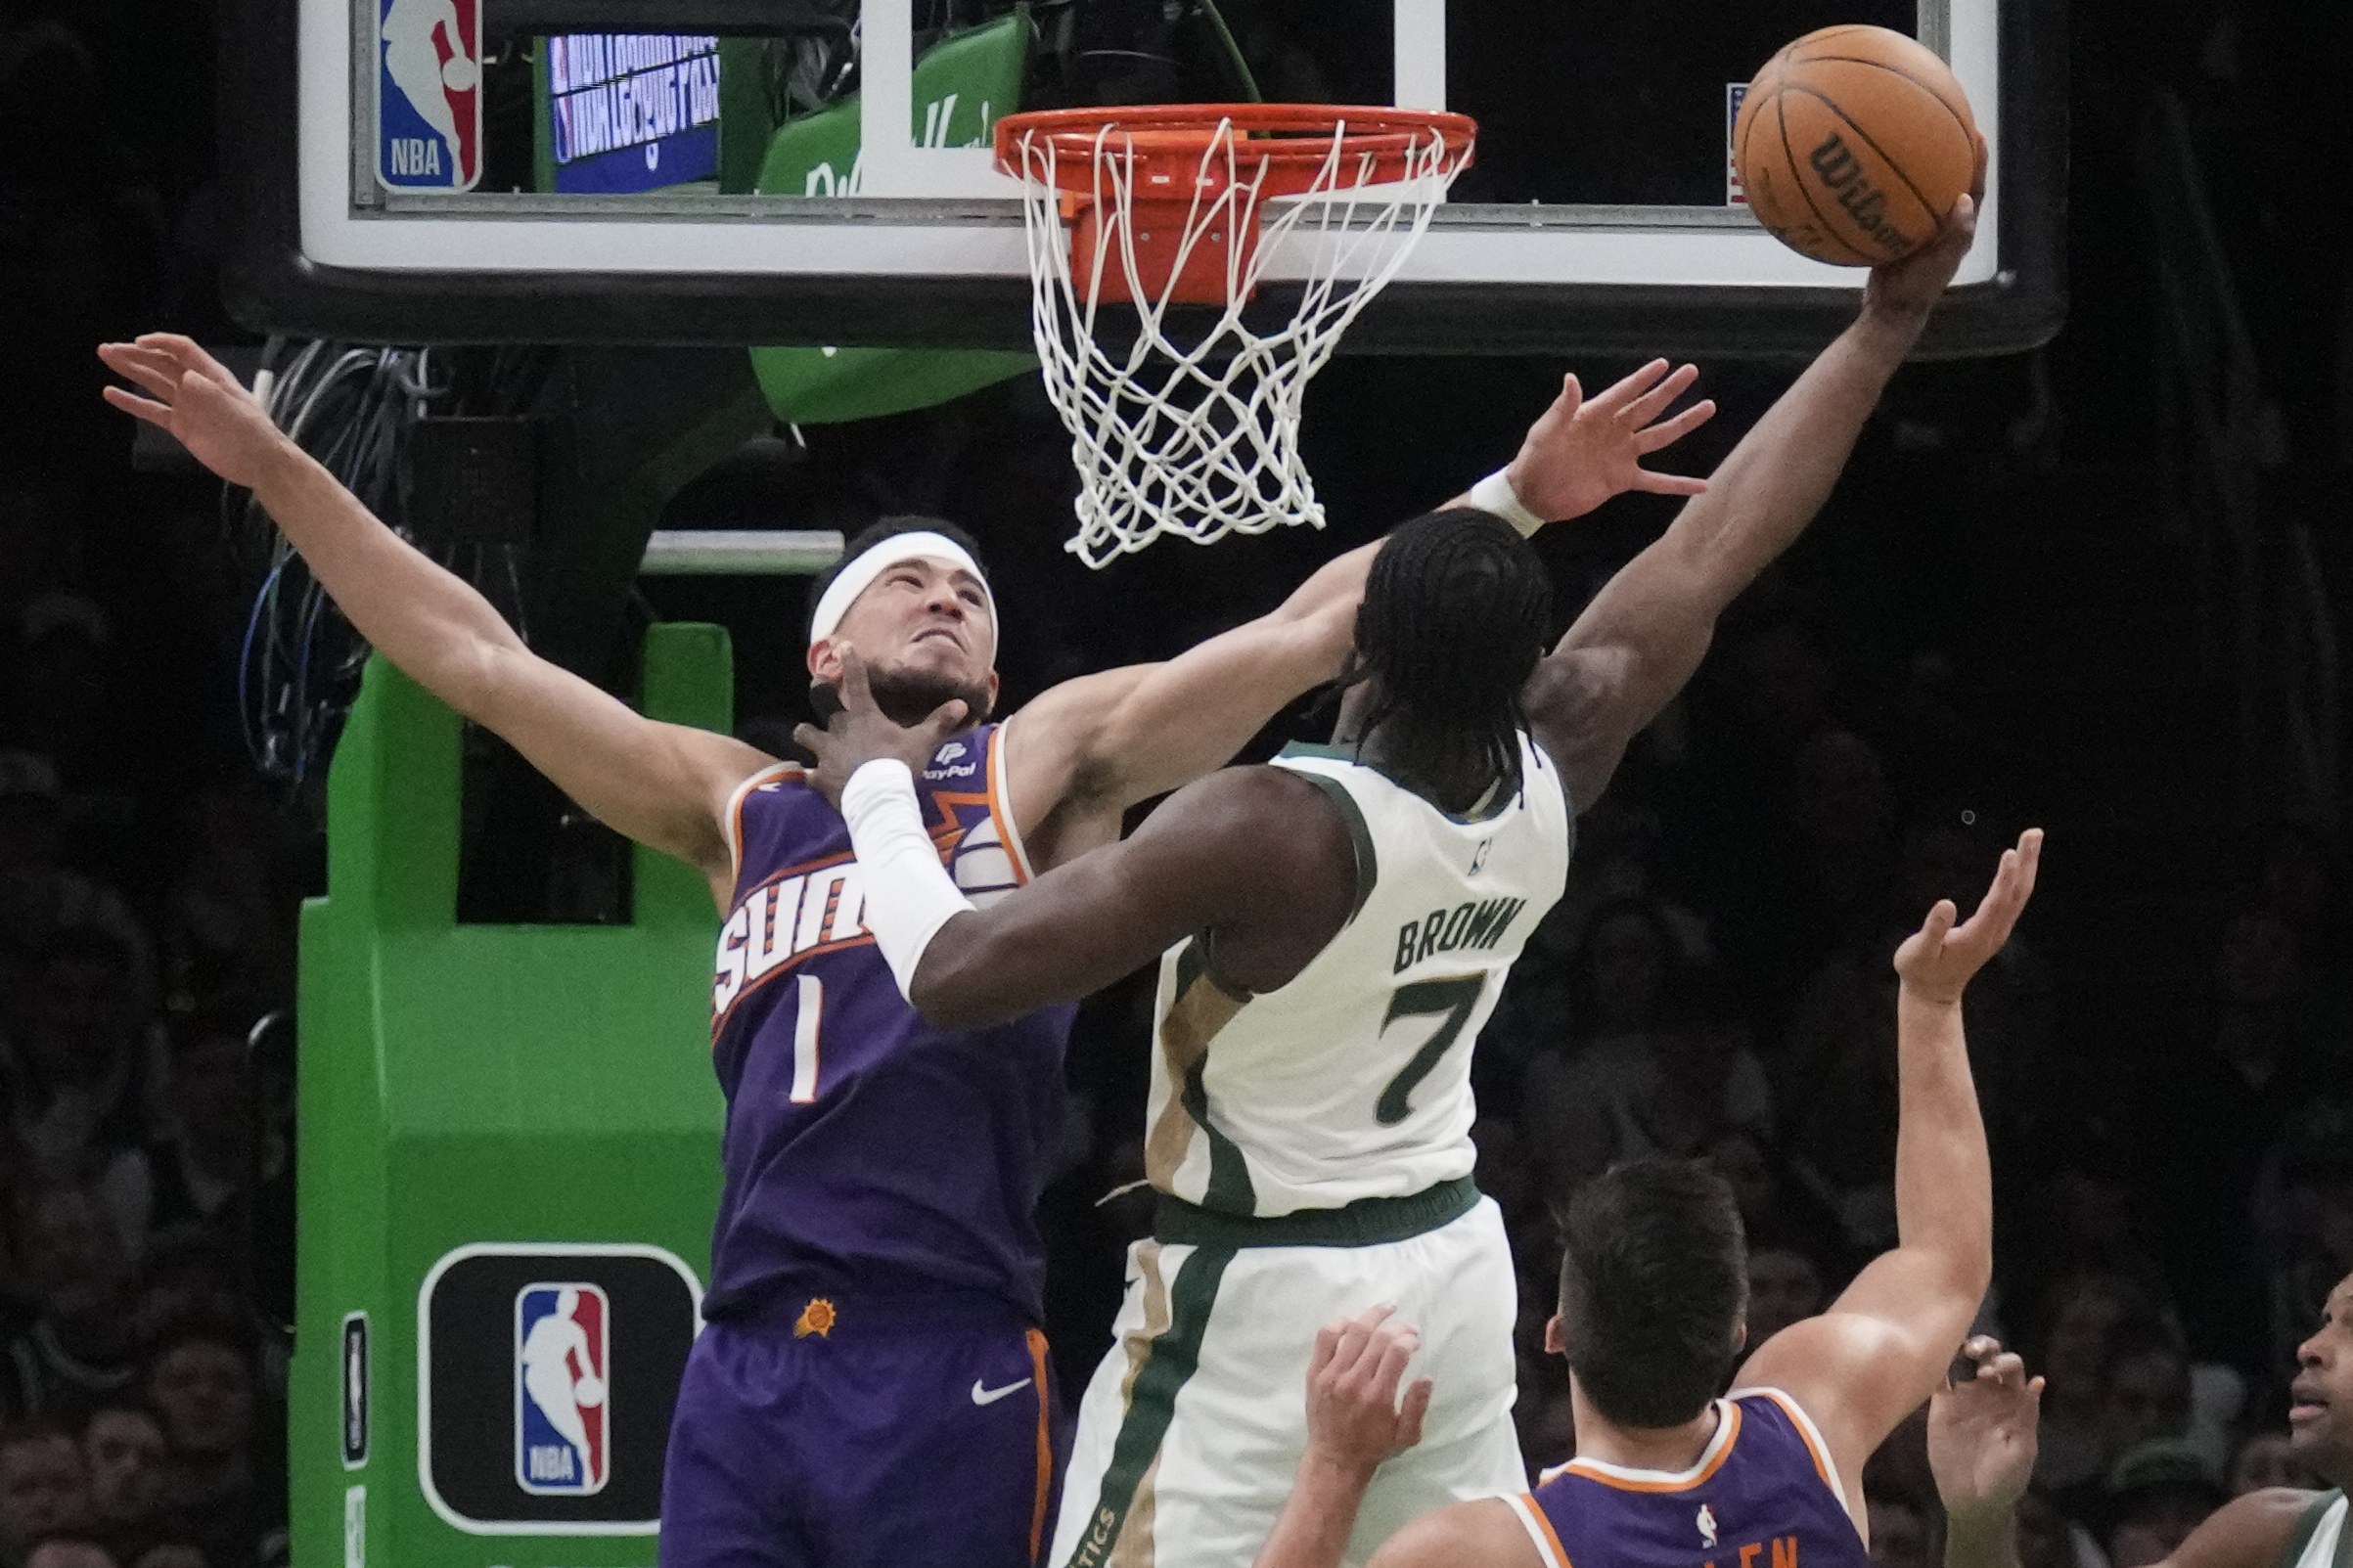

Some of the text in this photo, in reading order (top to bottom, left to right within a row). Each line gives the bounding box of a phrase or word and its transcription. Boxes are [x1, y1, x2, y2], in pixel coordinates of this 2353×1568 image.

[390, 137, 440, 176] NBA
[1810, 132, 1915, 254] Wilson
[713, 861, 874, 1016] SUN
[1393, 896, 1527, 975] BROWN
[789, 973, 824, 1103] 1
[1373, 968, 1488, 1128] 7
